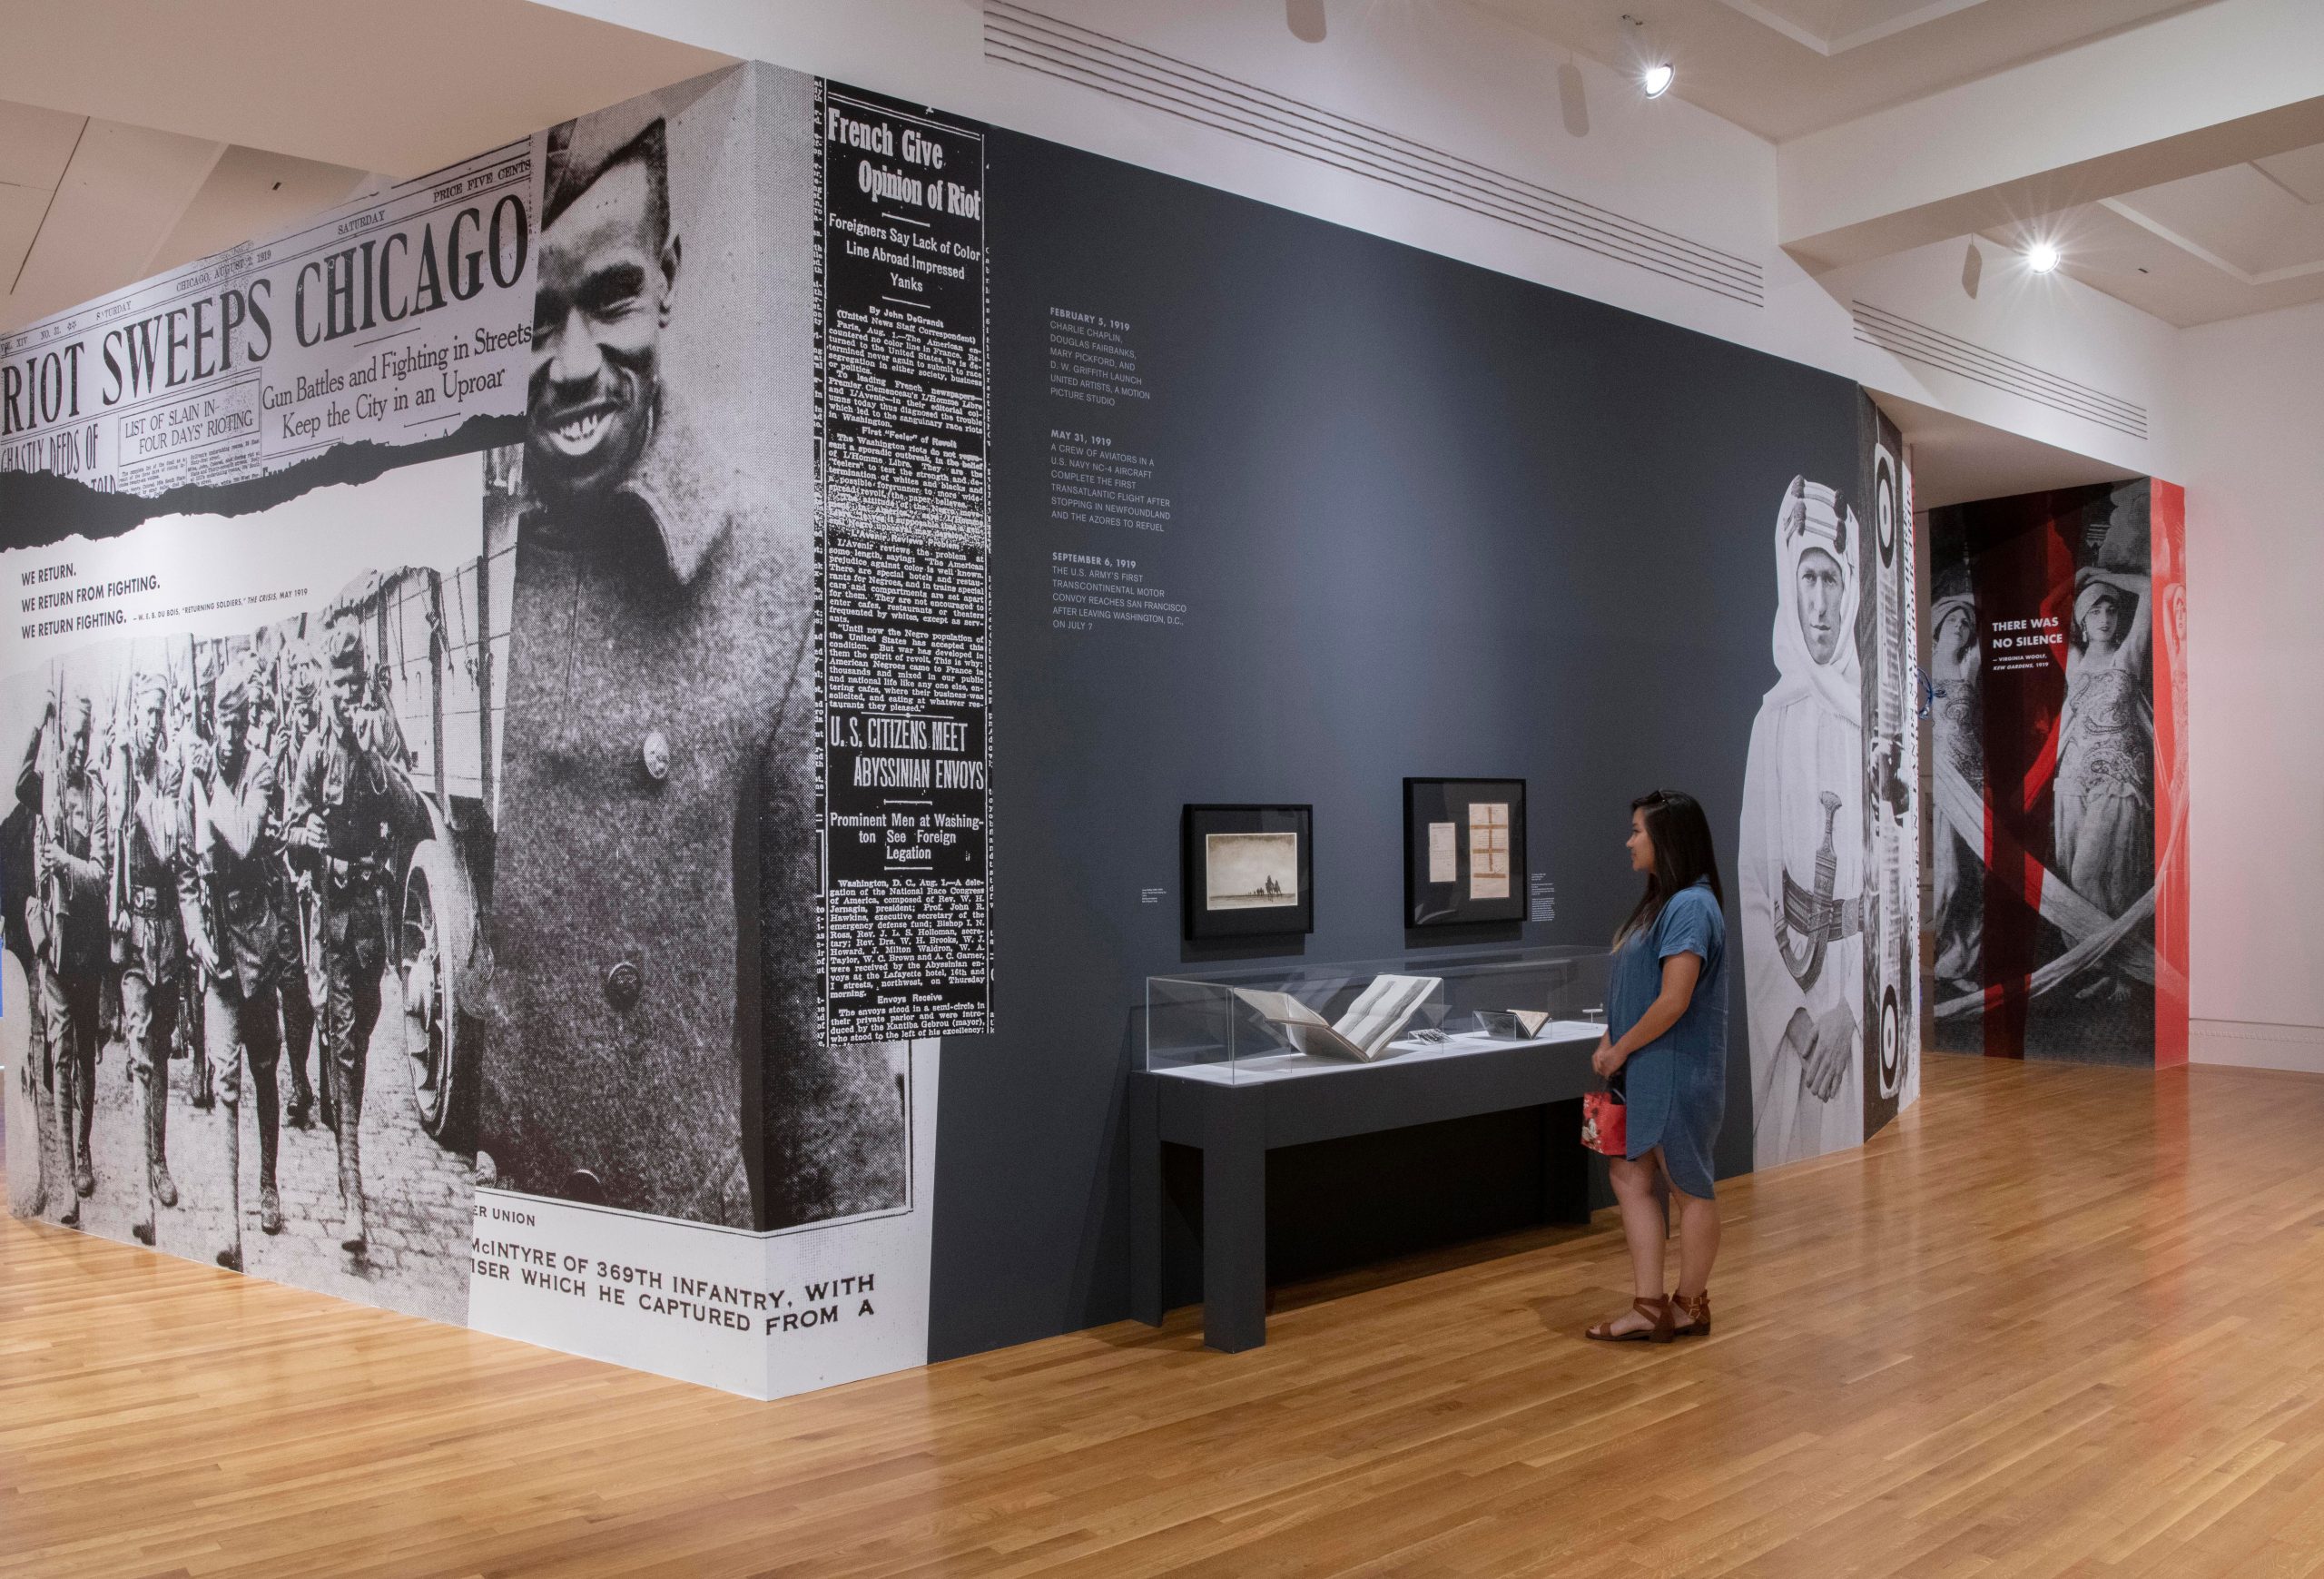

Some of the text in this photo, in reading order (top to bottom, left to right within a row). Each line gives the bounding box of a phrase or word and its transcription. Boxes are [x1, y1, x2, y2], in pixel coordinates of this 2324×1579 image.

[828, 107, 943, 169] French Give
[433, 160, 531, 202] PRICE FIVE CENTS
[858, 160, 980, 220] Opinion of Riot
[338, 210, 385, 234] SATURDAY
[829, 213, 980, 261] Foreigners Say Lack of Color
[177, 272, 210, 291] CHICAGO,
[214, 259, 244, 279] AUGUST
[257, 250, 271, 262] 1919
[846, 241, 965, 280] Line Abroad Impressed
[891, 272, 923, 291] Yanks
[2, 194, 528, 436] RIOT SWEEPS CHICAGO
[869, 306, 881, 316] By
[884, 310, 903, 320] John
[1050, 307, 1129, 331] FEBRUARY 5, 1919
[1050, 321, 1123, 343] CHARLIE CHAPLIN,
[1050, 334, 1137, 359] DOUGLAS FAIRBANKS,
[1050, 347, 1072, 358] MARY
[1119, 361, 1135, 370] AND
[262, 327, 532, 410] Gun Battles and Fighting in Streets
[1050, 361, 1142, 385] D. W. GRIFFITH LAUNCH
[1050, 374, 1078, 386] UNITED
[1080, 380, 1112, 393] ARTISTS,
[1121, 388, 1150, 400] MOTION
[1050, 388, 1115, 406] PICTURE STUDIO
[282, 367, 505, 439] Keep the City in an Uproar
[125, 417, 146, 438] LIST
[150, 413, 165, 430] OF
[169, 403, 200, 426] SLAIN
[139, 410, 253, 454] FOUR DAYS' RIOTING
[85, 423, 99, 469] OF
[1051, 429, 1111, 447] MAY 31, 1919
[1051, 498, 1092, 509] STOPPING
[1106, 505, 1170, 520] NEWFOUNDLAND
[1052, 552, 1136, 568] SEPTEMBER 6, 1919
[22, 563, 76, 587] WE RETURN.
[22, 575, 161, 613] WE RETURN FROM FIGHTING.
[1053, 579, 1165, 597] TRANSCONTINENTAL MOTOR
[22, 626, 35, 639] WE
[38, 617, 74, 637] RETURN
[76, 609, 127, 632] FIGHTING.
[259, 593, 277, 602] CRISIS,
[294, 588, 308, 597] 1919
[1053, 593, 1087, 603] CONVOY
[1089, 597, 1124, 607] REACHES
[1145, 602, 1187, 612] FRANCISCO
[1993, 617, 2059, 632] THERE WAS
[1993, 634, 2063, 648] NO SILENCE
[831, 715, 968, 752] U. S. CITIZENS MEET
[853, 756, 984, 789] ABYSSINIAN ENVOYS
[831, 813, 984, 830] Prominent Men at Washing-
[859, 830, 956, 845] ton See Foreign
[886, 845, 931, 862] Legation
[877, 994, 942, 1004] Envoys Receive
[492, 1209, 535, 1227] UNION
[564, 1255, 588, 1274] OF
[596, 1262, 662, 1289] 369TH
[673, 1278, 793, 1310] INFANTRY,
[806, 1274, 875, 1302] WITH
[521, 1269, 586, 1298] WHICH
[599, 1288, 625, 1306] HE
[638, 1294, 751, 1331] CAPTURED
[765, 1307, 838, 1336] FROM
[858, 1299, 874, 1316] A
